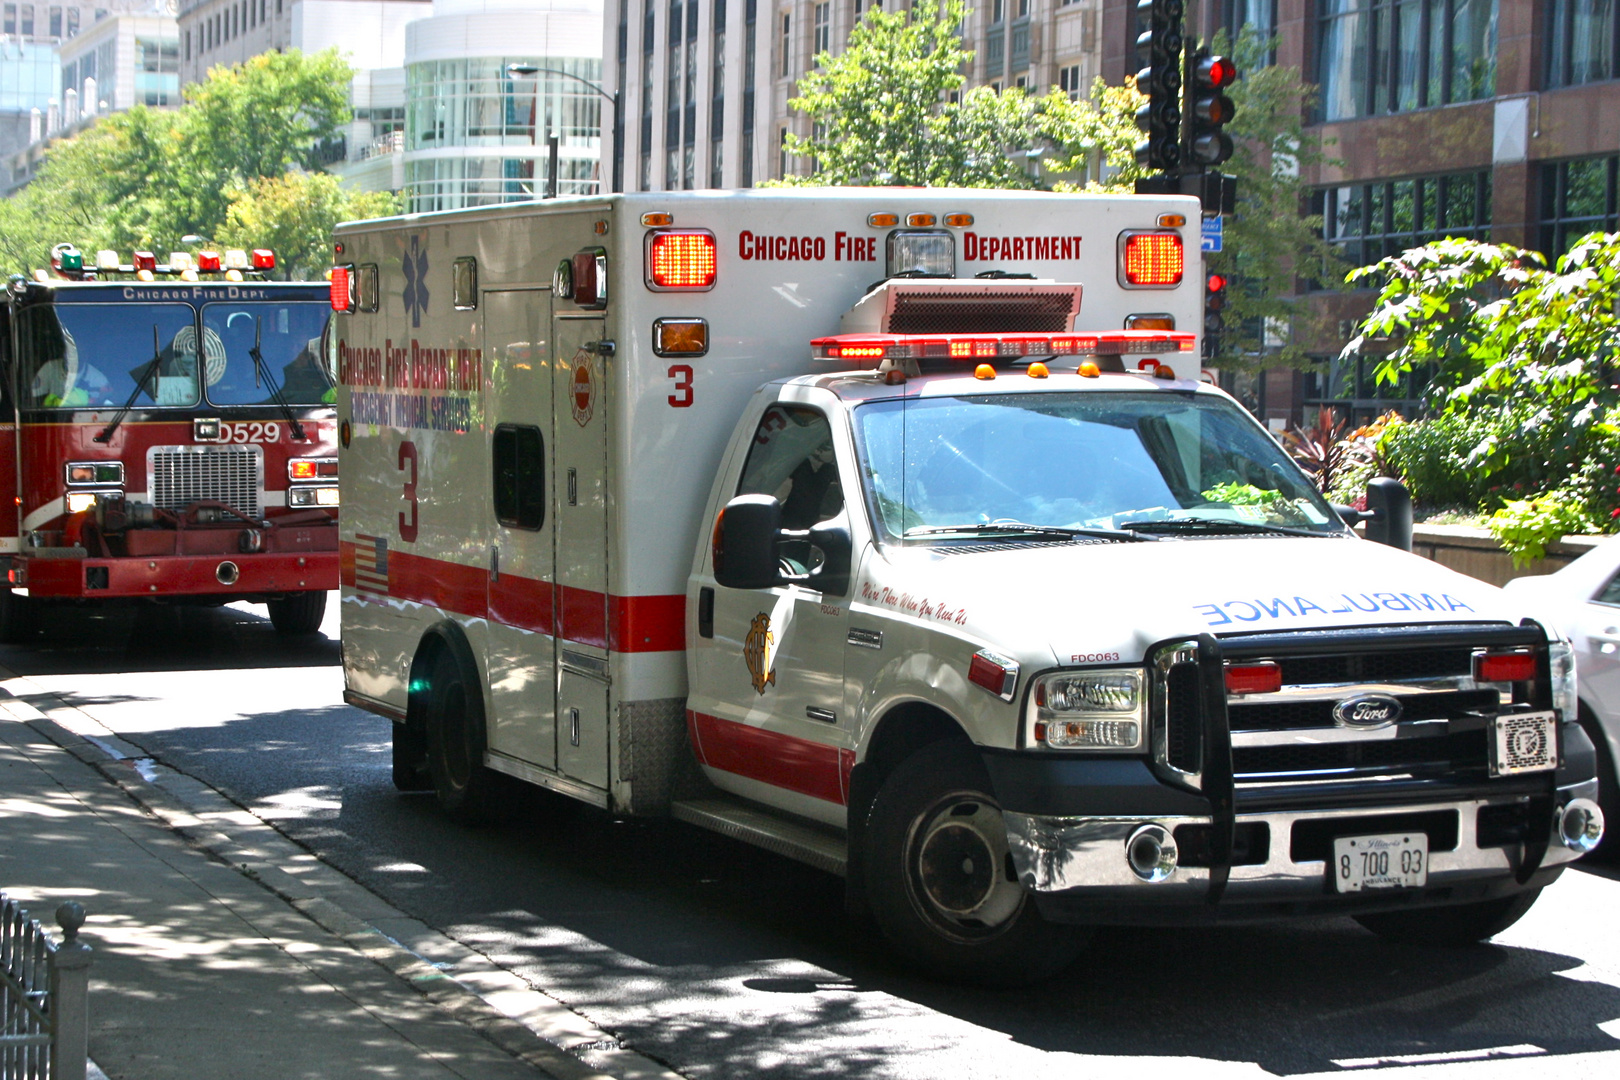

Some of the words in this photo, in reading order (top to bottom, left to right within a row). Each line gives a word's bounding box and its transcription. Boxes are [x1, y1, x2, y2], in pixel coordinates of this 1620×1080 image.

[739, 230, 825, 260] CHICAGO
[834, 231, 876, 261] FIRE
[963, 231, 1082, 261] DEPARTMENT
[123, 287, 189, 299] CHICAGO
[193, 287, 225, 299] FIRE
[339, 338, 382, 386] CHICAGO
[385, 339, 408, 388] FIRE
[411, 339, 482, 391] DEPARTMENT
[668, 365, 694, 408] 3
[351, 391, 393, 427] EMERGENCY
[395, 393, 429, 429] MEDICAL
[431, 396, 470, 432] SERVICES
[217, 422, 280, 443] D529
[398, 441, 418, 543] 3
[1352, 701, 1389, 720] Ford
[1341, 854, 1350, 880] 8
[1360, 850, 1389, 877] 700
[1401, 849, 1423, 874] 03
